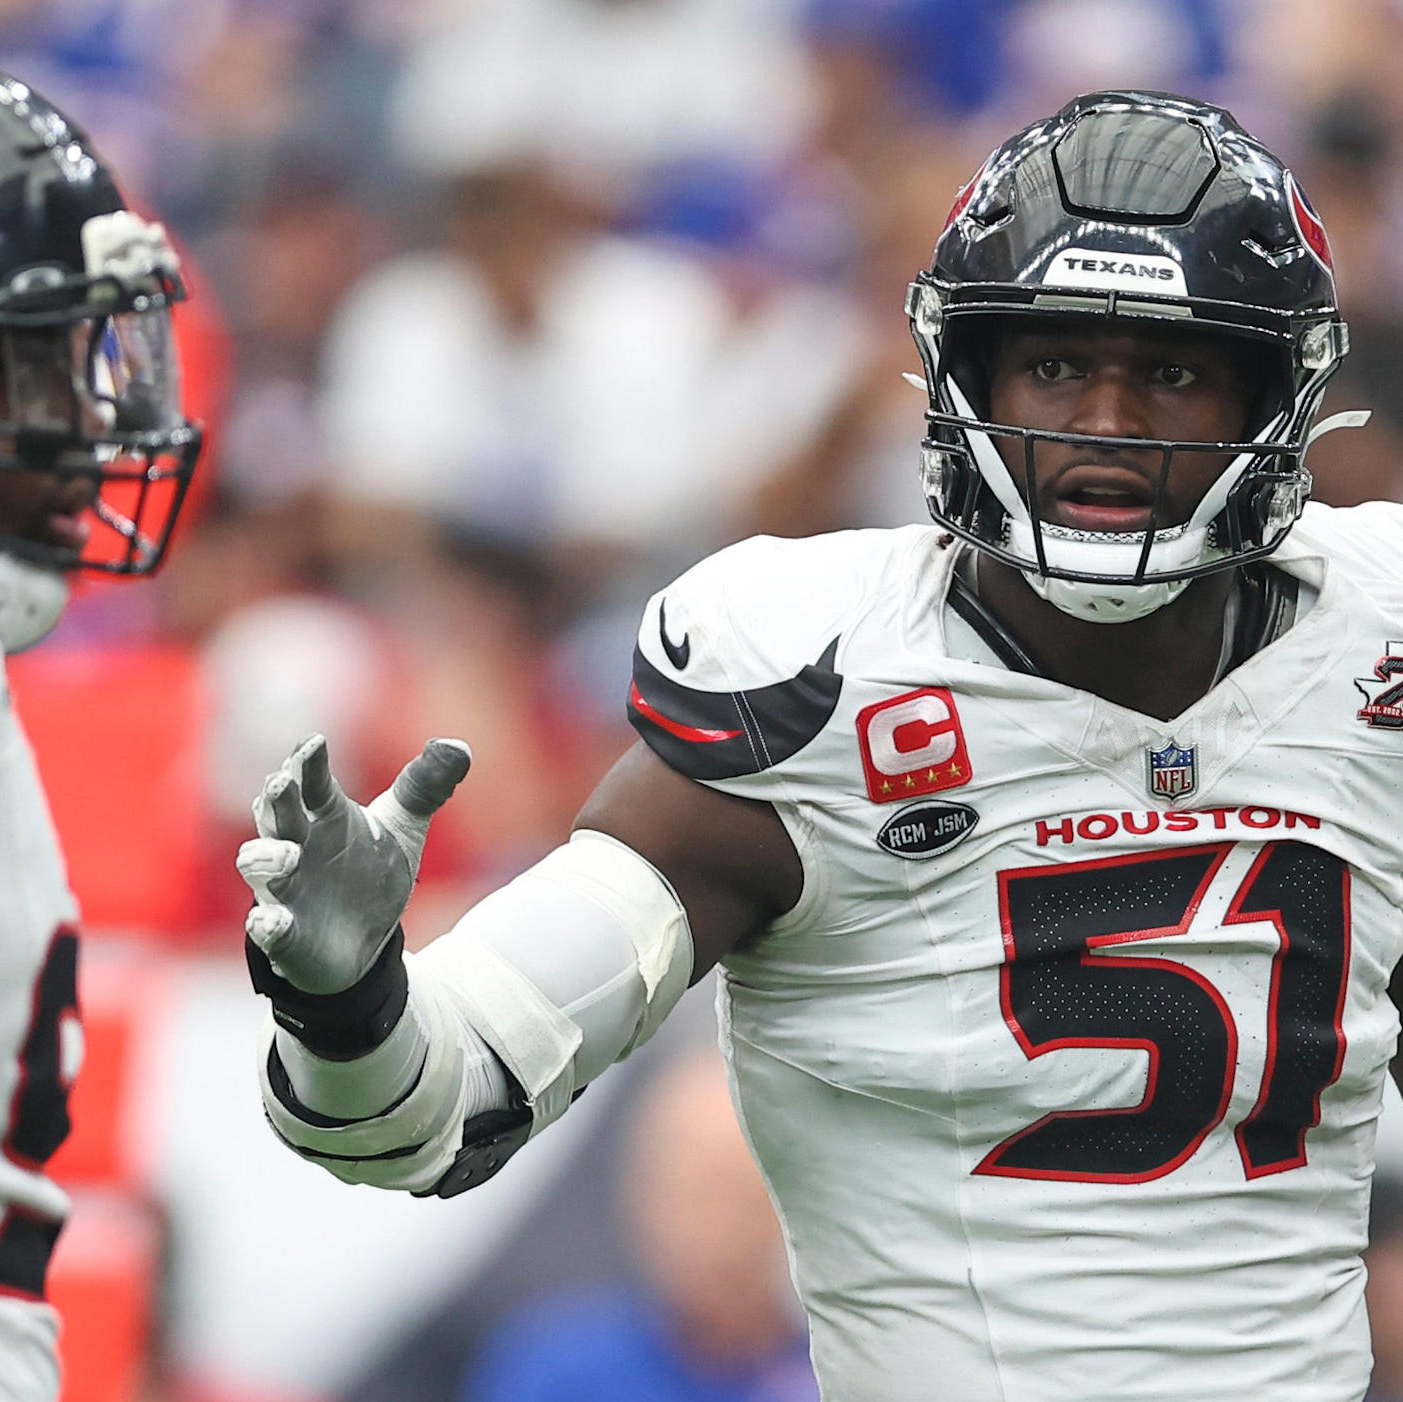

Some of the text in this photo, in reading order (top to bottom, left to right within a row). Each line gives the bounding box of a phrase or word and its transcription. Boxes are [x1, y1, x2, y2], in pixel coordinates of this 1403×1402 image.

[1063, 257, 1175, 281] TEXANS
[867, 694, 958, 776] C
[1154, 769, 1191, 794] NFL
[888, 811, 968, 848] RCM JSM
[1035, 805, 1321, 846] HOUSTON
[970, 839, 1351, 1184] 51
